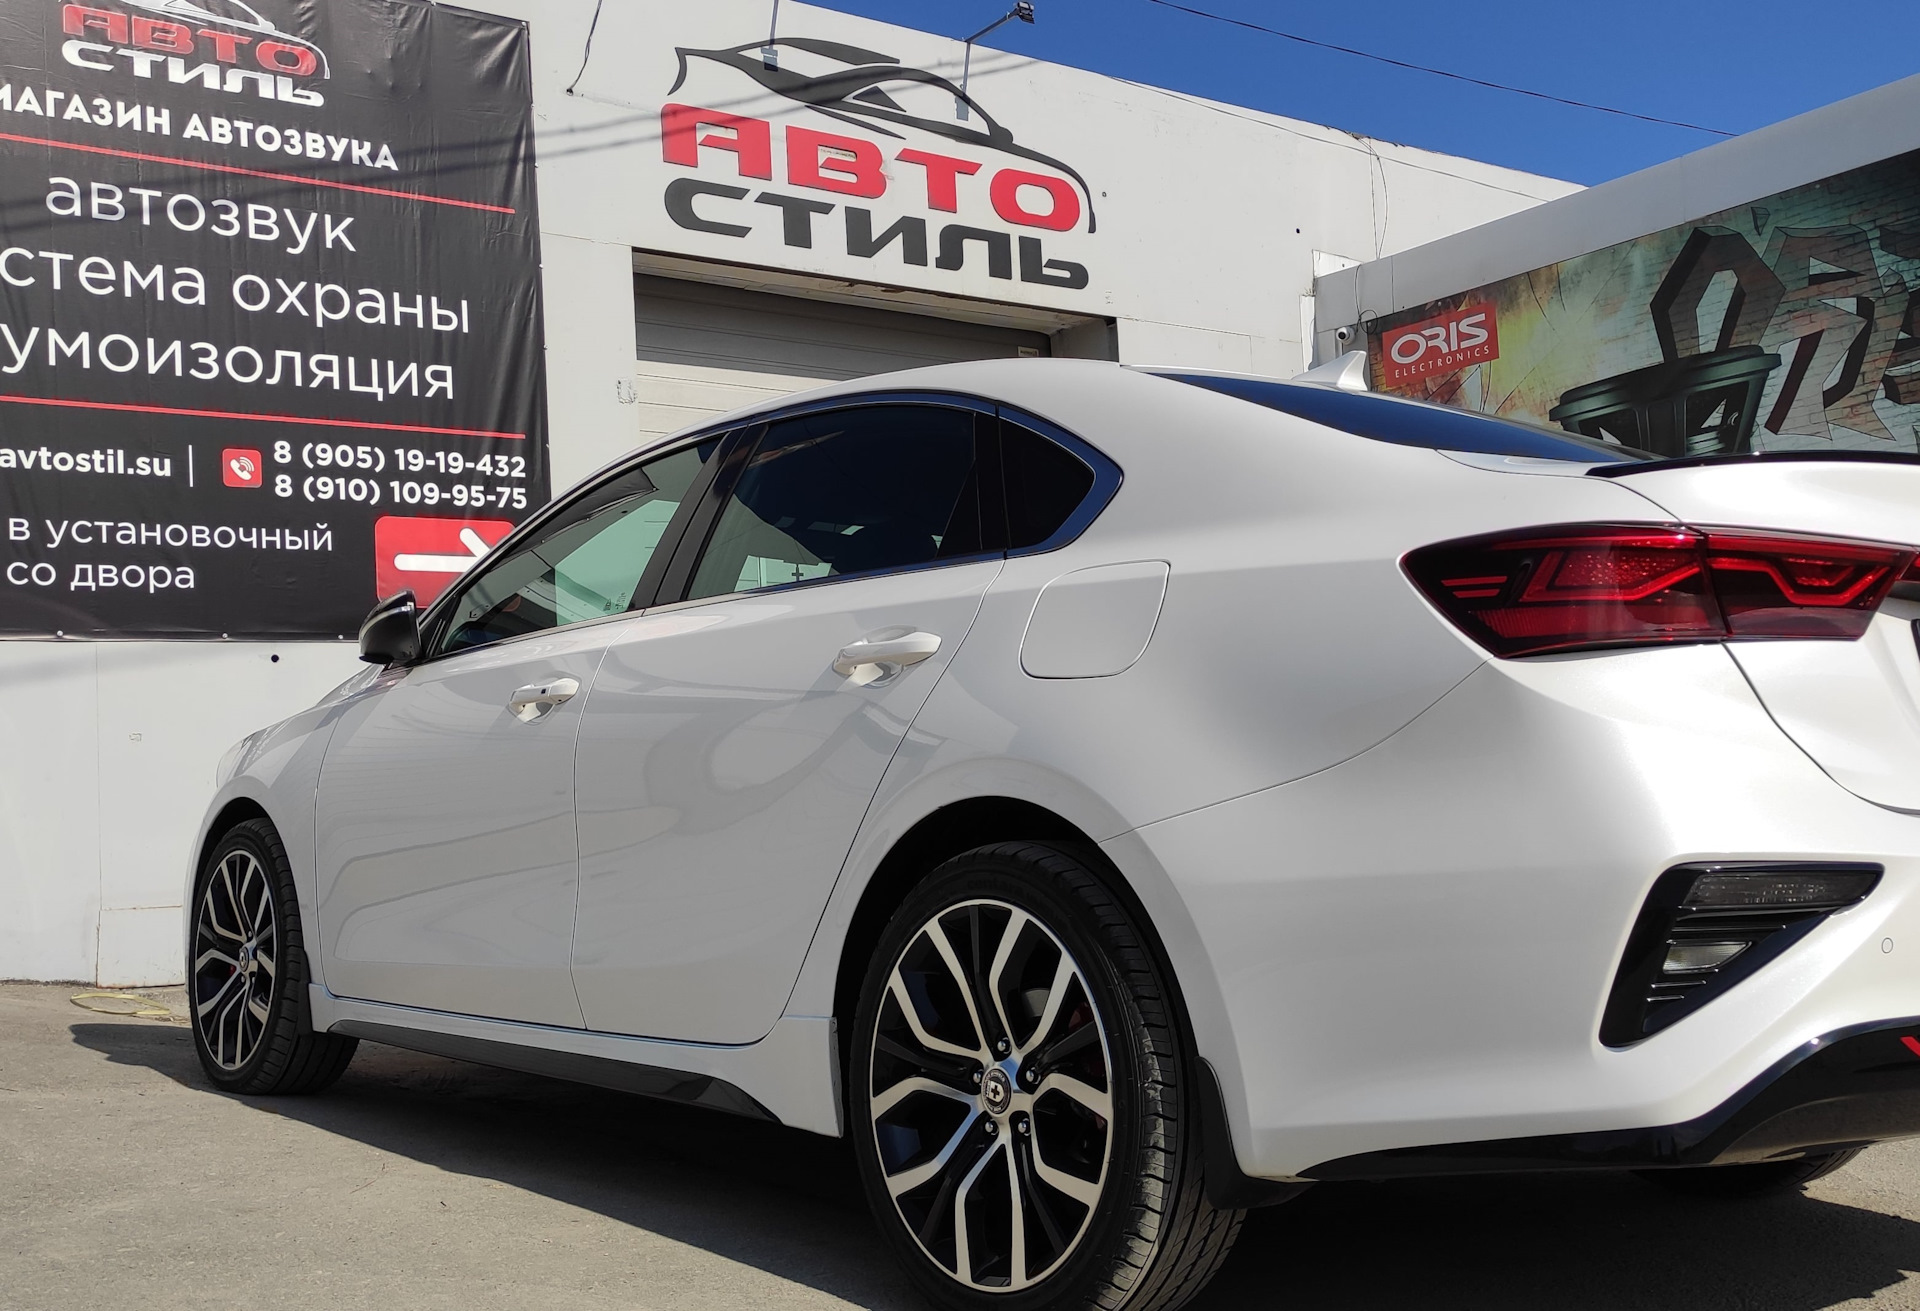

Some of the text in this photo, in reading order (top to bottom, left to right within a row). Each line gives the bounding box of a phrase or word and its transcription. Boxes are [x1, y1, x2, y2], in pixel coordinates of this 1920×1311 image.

[62, 4, 317, 76] АВТО
[62, 40, 324, 106] СТИЛЬ
[183, 114, 398, 170] АВТОЗВУКА
[661, 103, 1080, 232] АВТО
[46, 177, 356, 254] автозвук
[665, 178, 1088, 289] СТИЛЬ
[233, 275, 468, 332] охраны
[0, 320, 454, 401] умоизоляция
[1391, 313, 1488, 364] ORIS
[1395, 345, 1489, 378] ELECTRONICS
[0, 447, 170, 476] avtostil.su
[274, 441, 525, 477] 8 (905) 19-19-432
[275, 475, 526, 509] 8 (910) 109-95-75
[9, 517, 333, 552] в установочный
[7, 562, 194, 593] со двора
